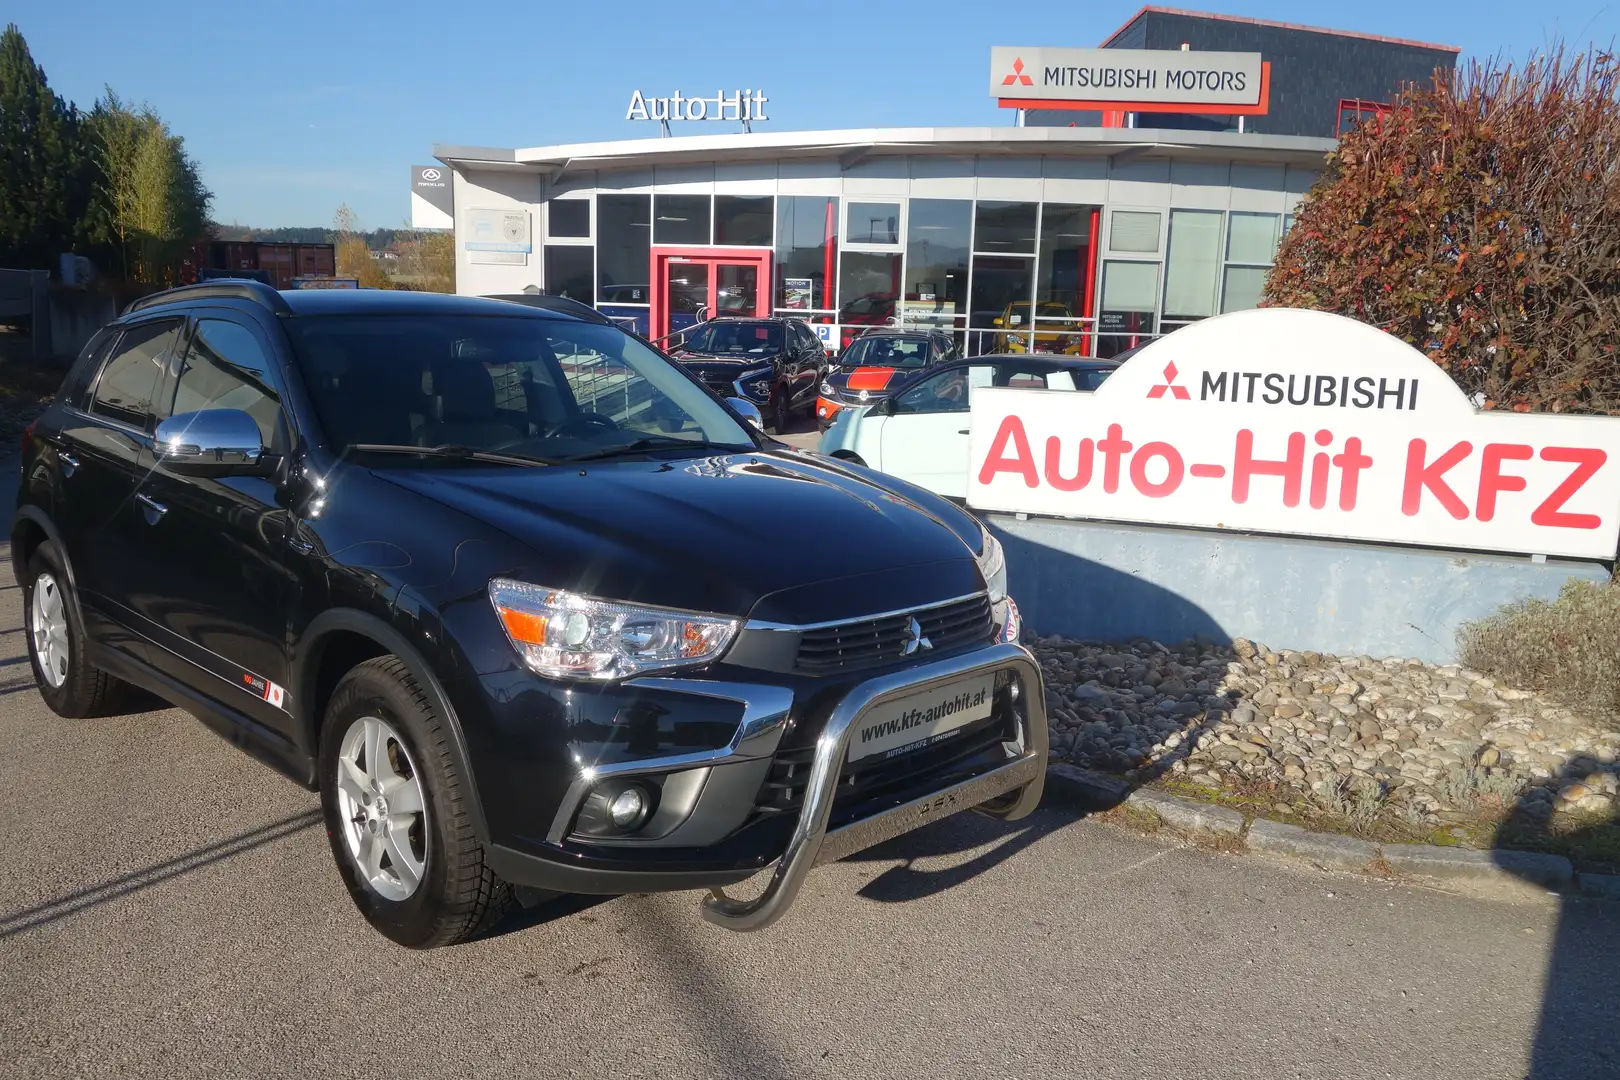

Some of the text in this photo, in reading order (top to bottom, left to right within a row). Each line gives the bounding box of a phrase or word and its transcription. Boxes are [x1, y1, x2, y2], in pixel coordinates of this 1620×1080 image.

[1044, 67, 1246, 91] MITSUBISHI MOTORS
[626, 88, 770, 121] Auto Hit
[819, 327, 828, 340] P
[1201, 371, 1419, 411] MITSUBISHI
[978, 415, 1608, 530] Auto-Hit KFZ
[861, 687, 986, 744] www.kfz-autohit.at
